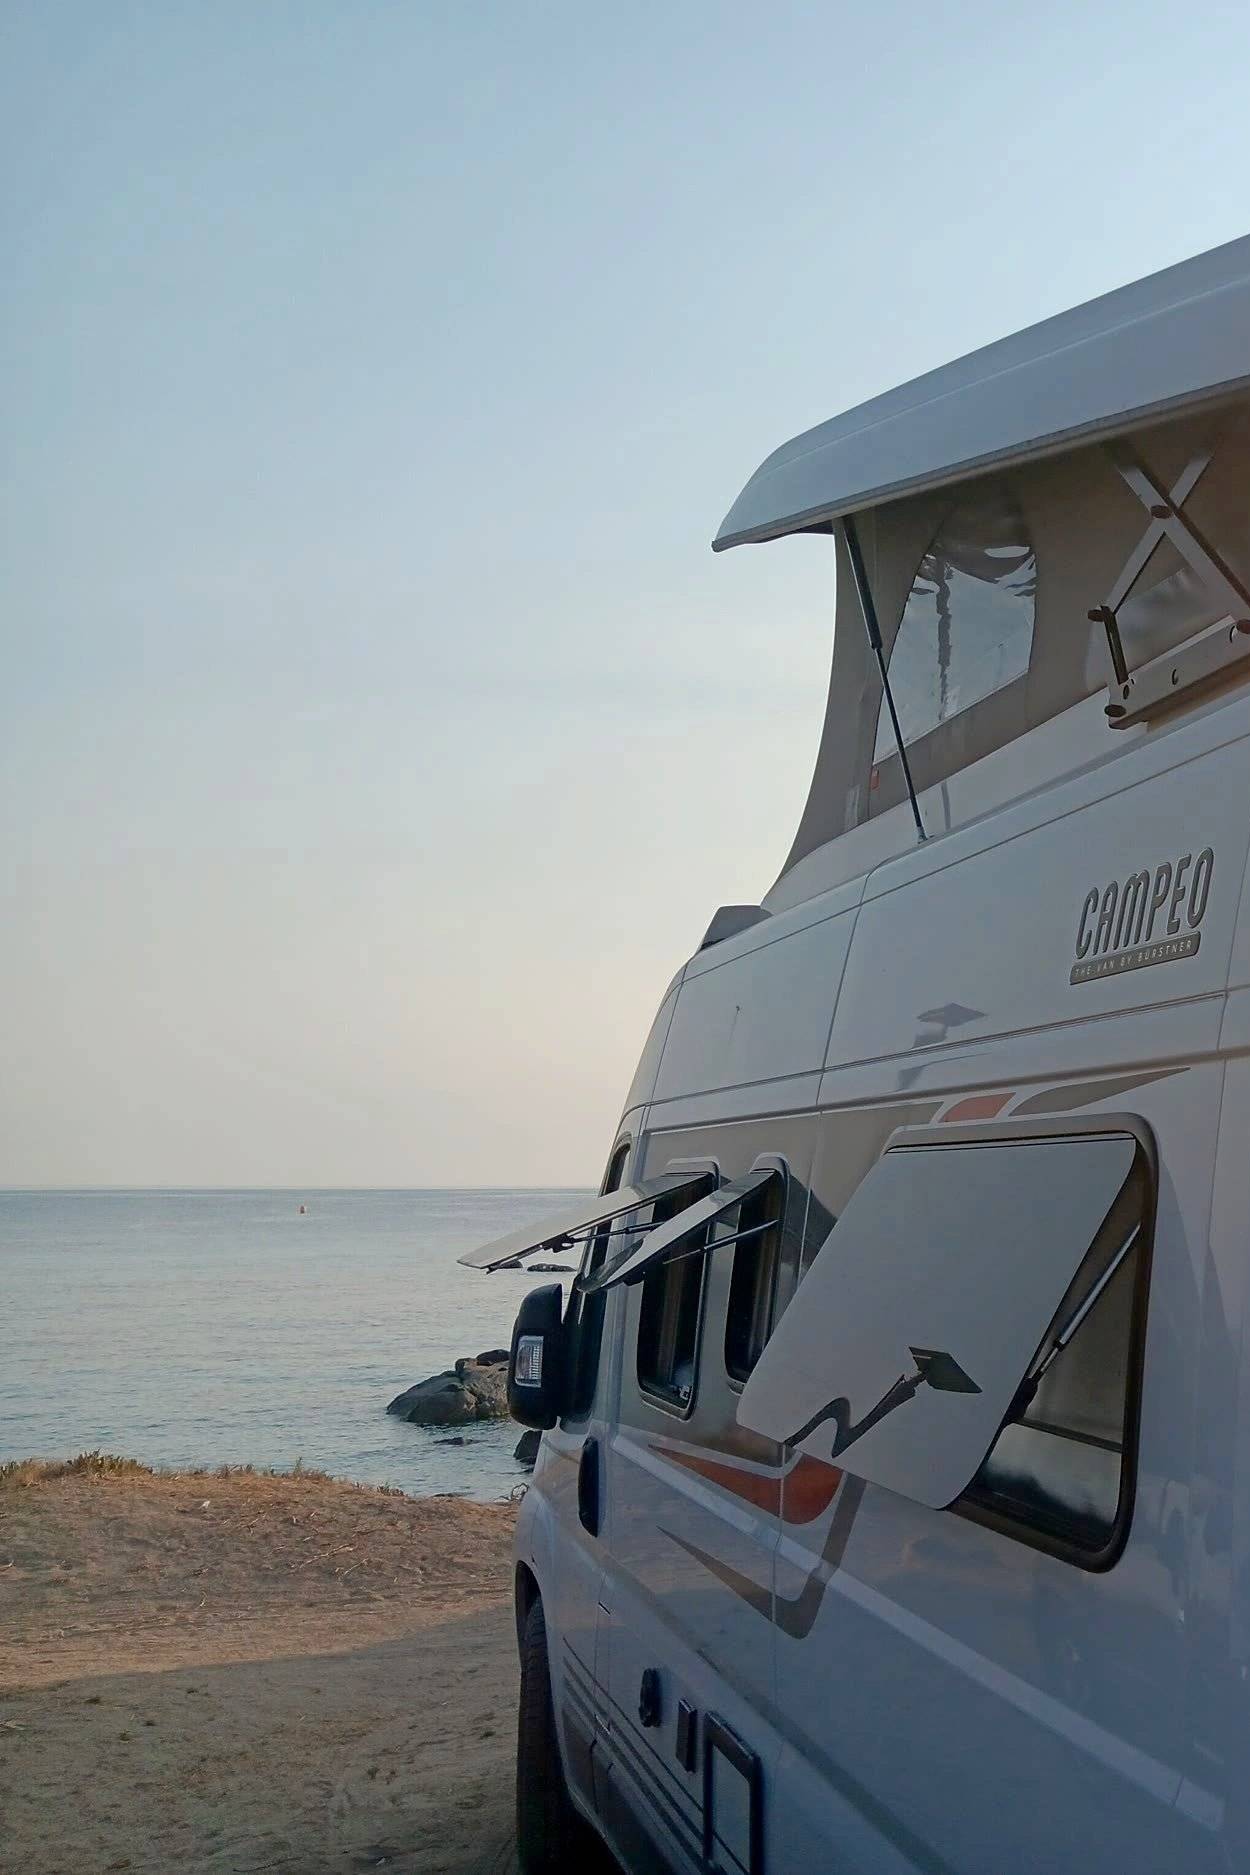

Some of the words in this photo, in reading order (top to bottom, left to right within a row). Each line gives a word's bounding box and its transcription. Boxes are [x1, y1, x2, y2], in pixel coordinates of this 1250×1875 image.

[1075, 847, 1214, 959] CAMPEO
[1074, 965, 1092, 977] THE
[1097, 960, 1115, 973] VAN
[1120, 955, 1133, 967] BY
